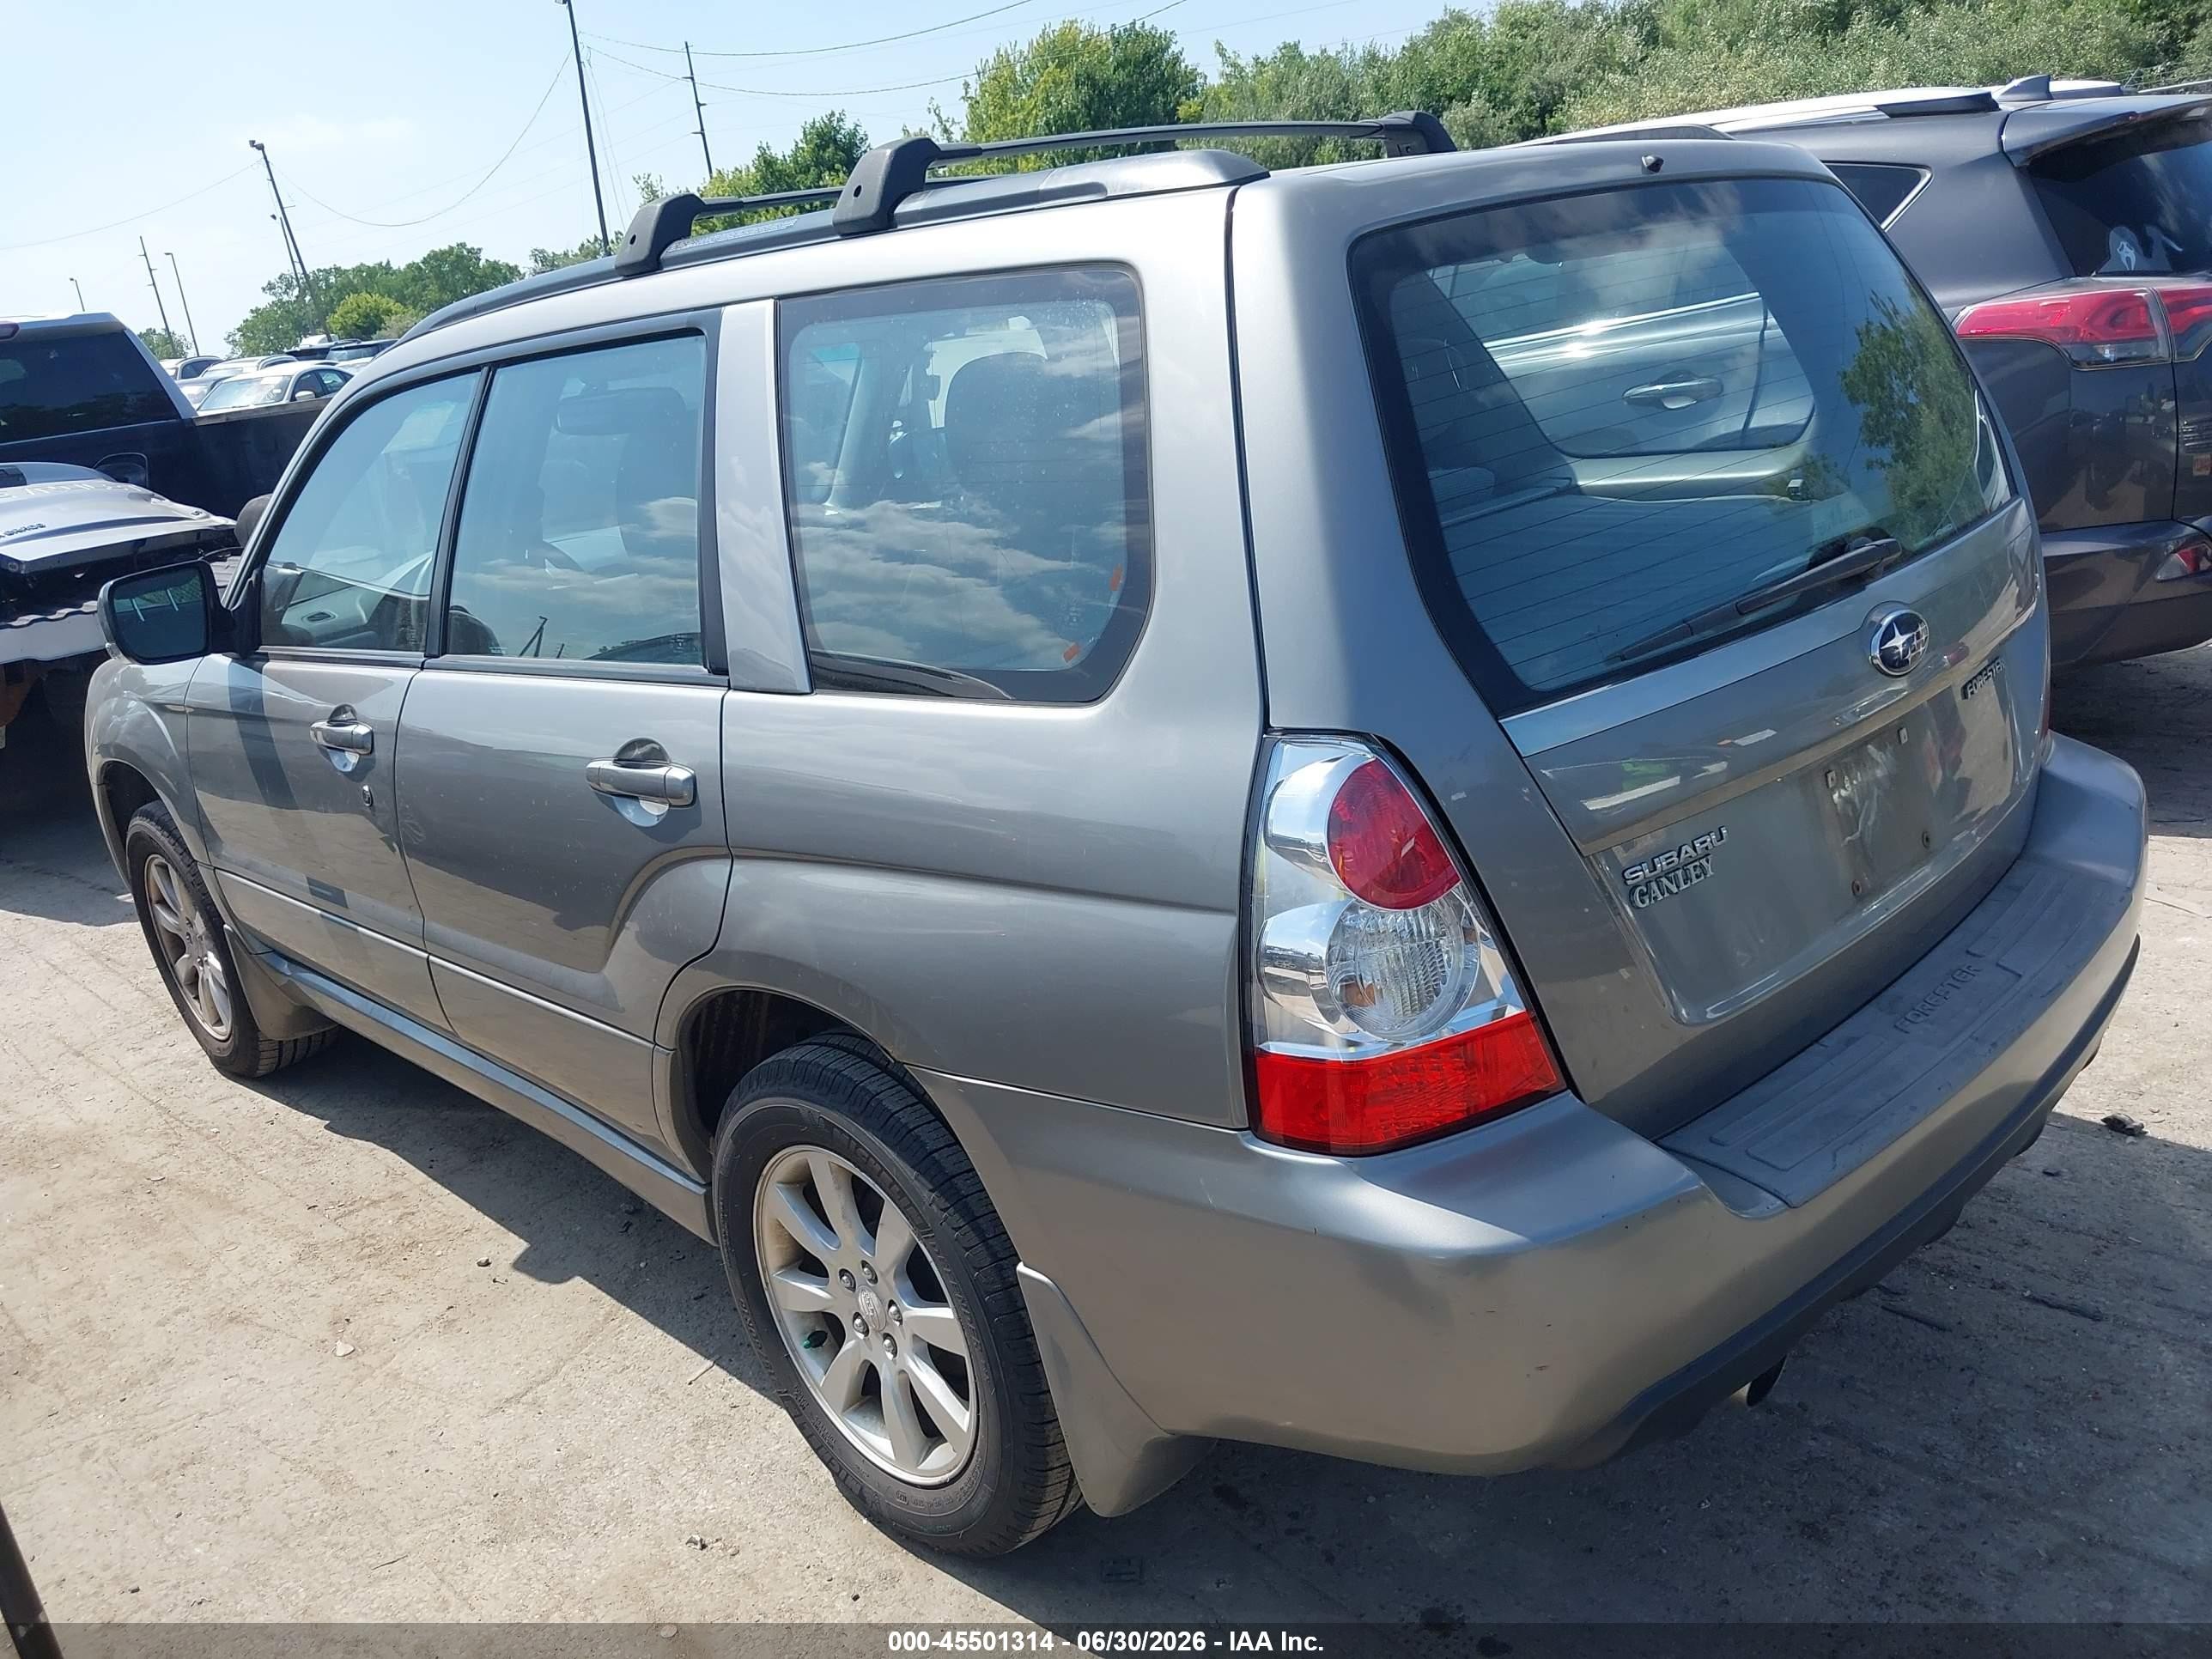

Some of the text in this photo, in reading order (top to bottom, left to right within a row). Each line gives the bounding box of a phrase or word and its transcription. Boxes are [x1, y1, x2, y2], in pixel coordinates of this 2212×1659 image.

[1964, 657, 2006, 700] FORESTER
[1623, 825, 1729, 885] SUBARU
[1893, 964, 1983, 1035] FORESTER
